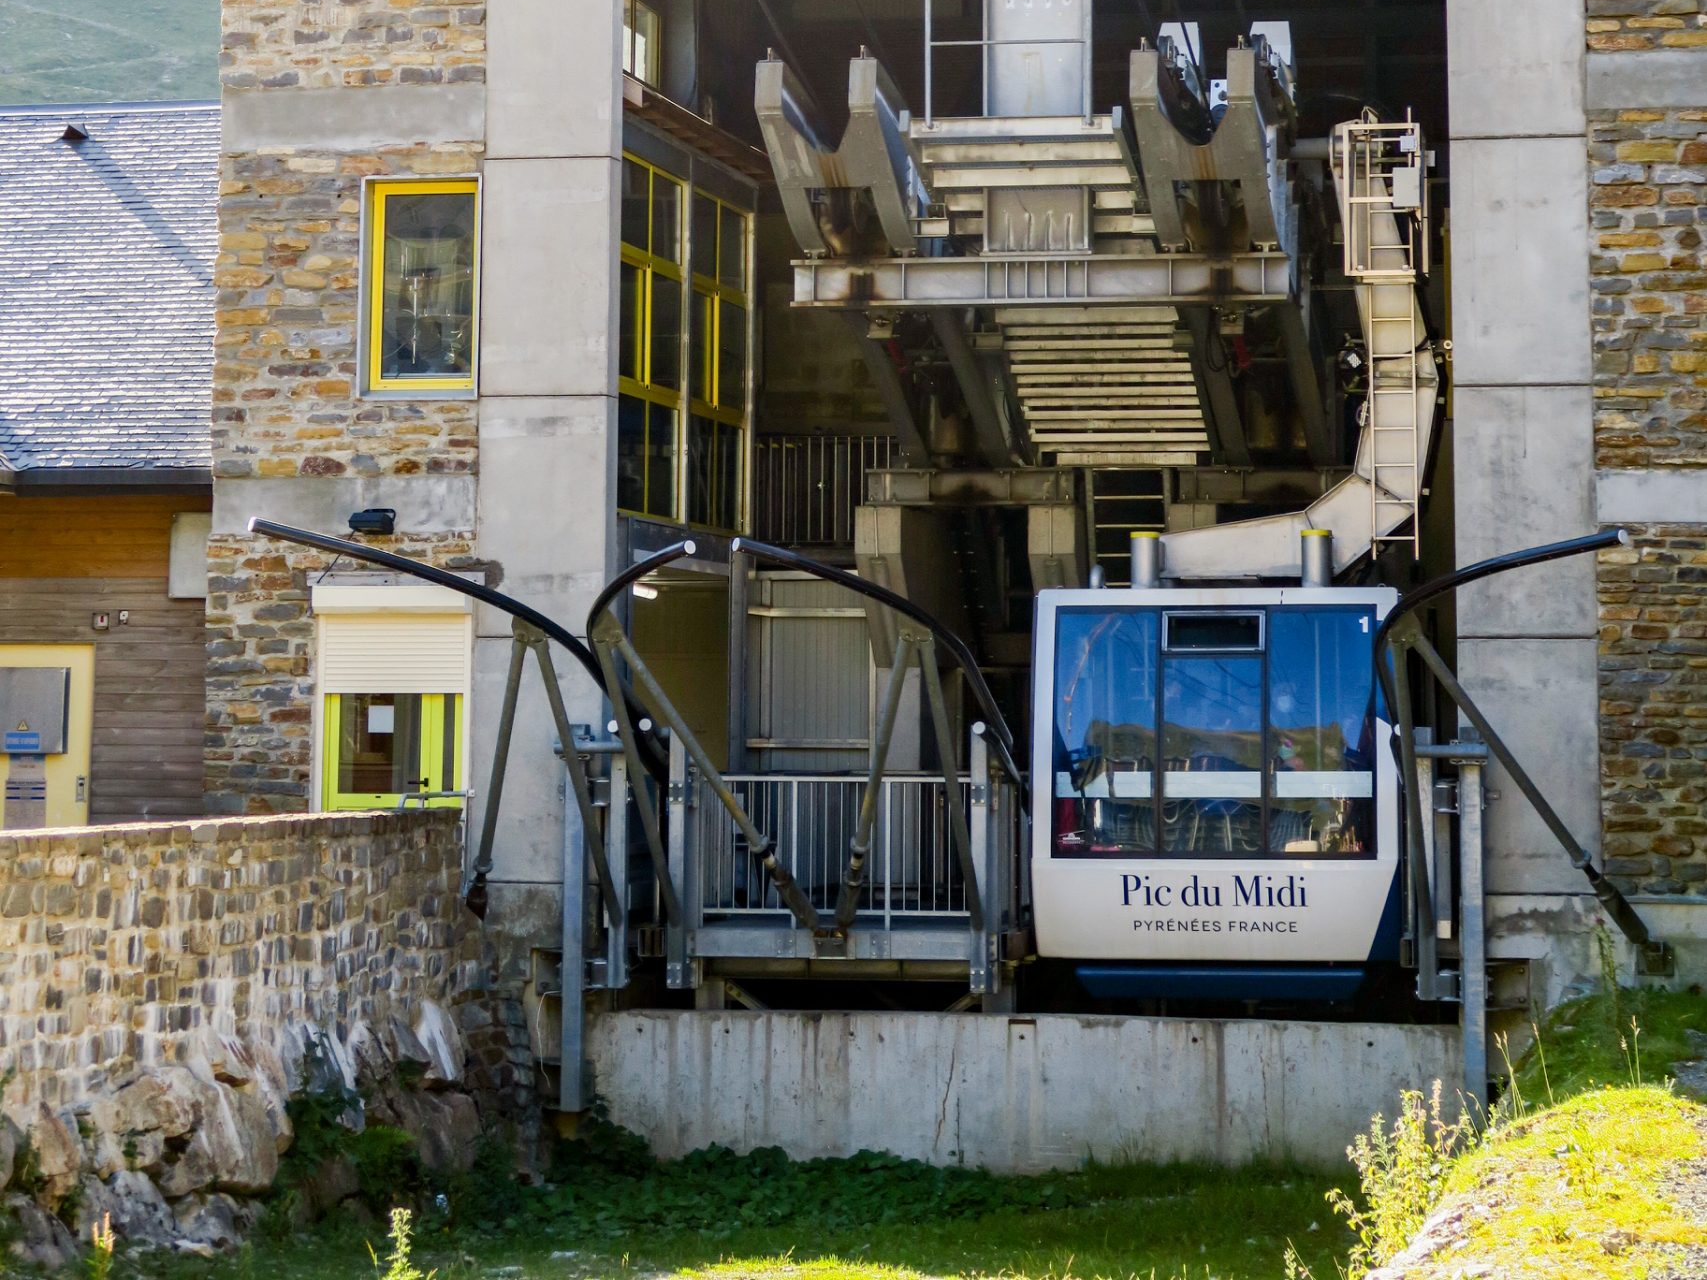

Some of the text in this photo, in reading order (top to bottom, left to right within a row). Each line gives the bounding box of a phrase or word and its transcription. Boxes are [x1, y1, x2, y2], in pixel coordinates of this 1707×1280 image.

[1358, 615, 1369, 634] 1
[1119, 874, 1309, 908] Pic du Midi
[1133, 917, 1299, 934] PYRÉNÉES FRANCE
